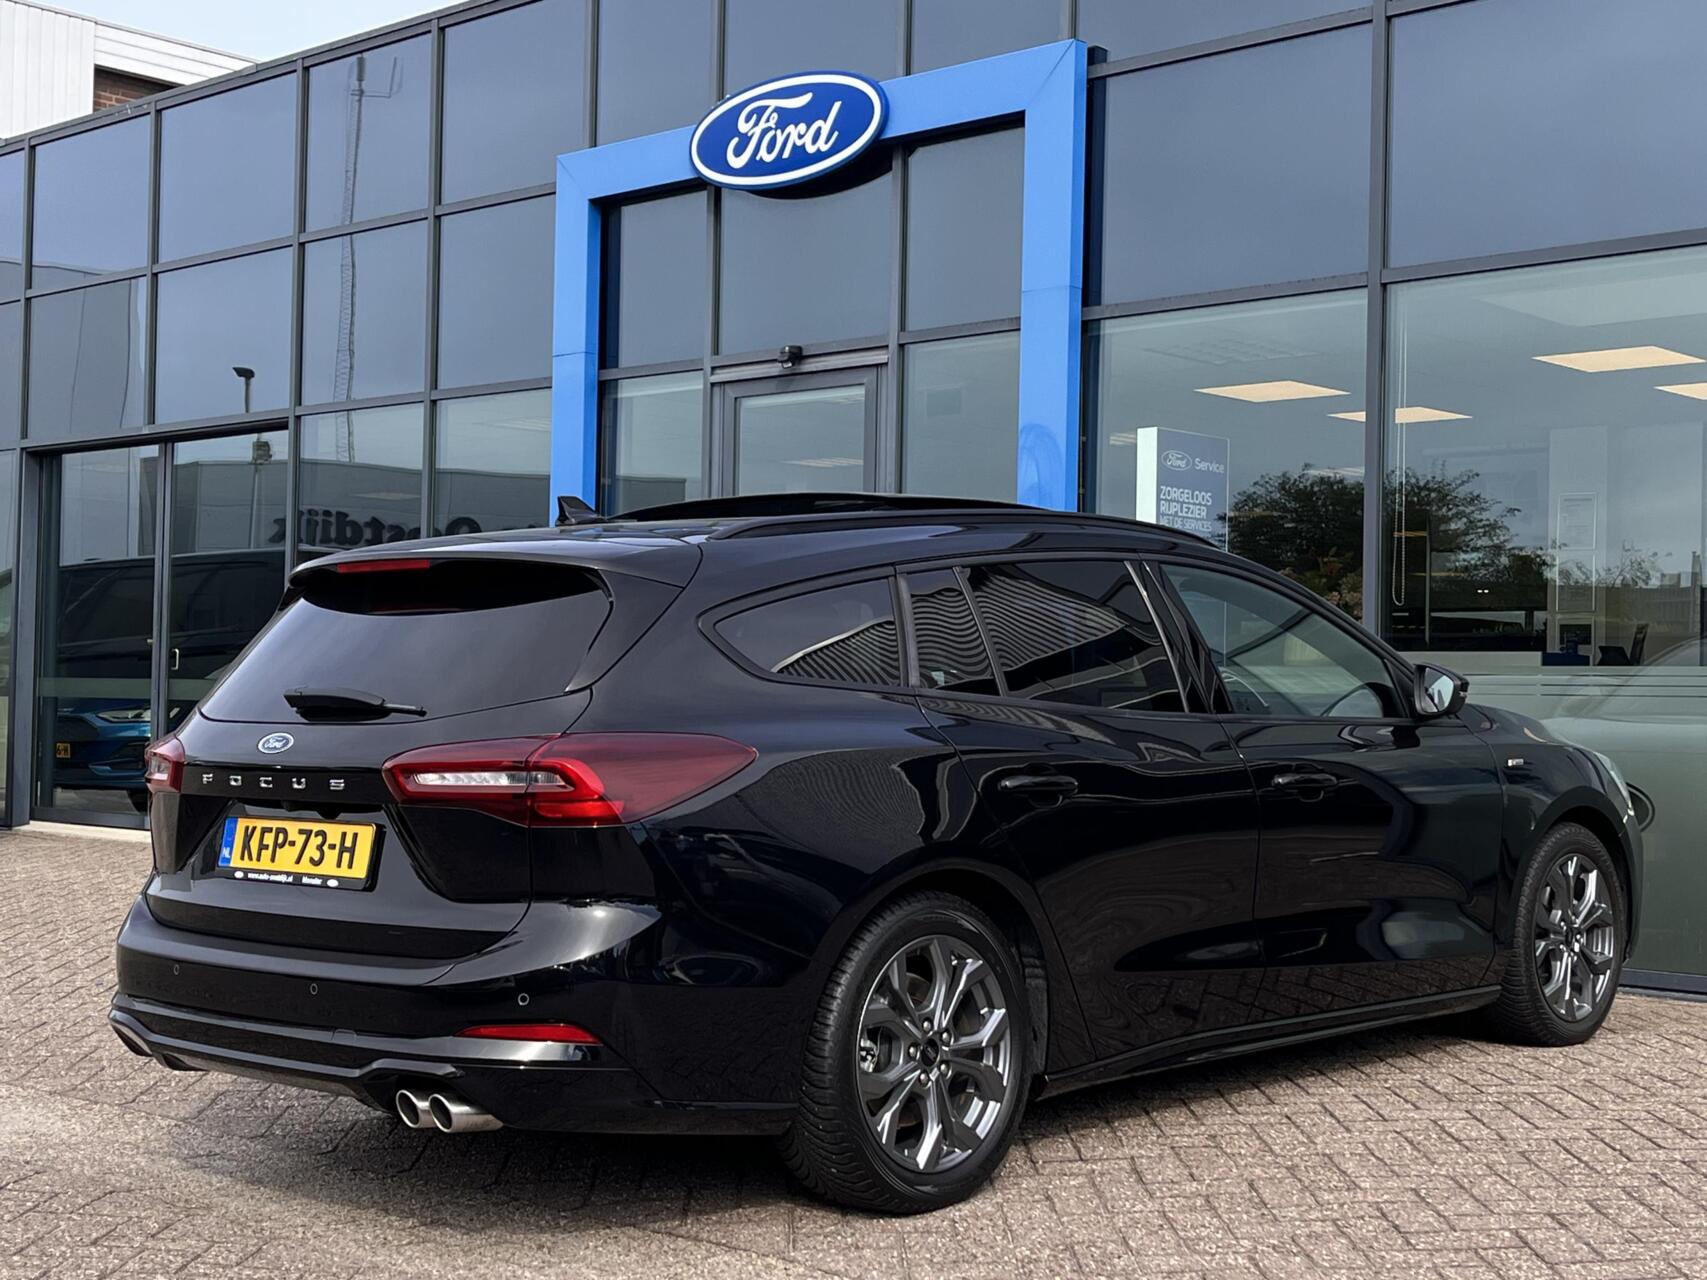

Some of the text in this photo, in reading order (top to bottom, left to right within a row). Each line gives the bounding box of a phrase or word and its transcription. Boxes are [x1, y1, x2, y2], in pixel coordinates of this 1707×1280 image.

[726, 92, 842, 169] Ford
[1194, 457, 1224, 474] Service
[1160, 486, 1212, 505] ZORGELOOS
[202, 773, 345, 790] FOCUS
[240, 825, 359, 869] KFP-73-H
